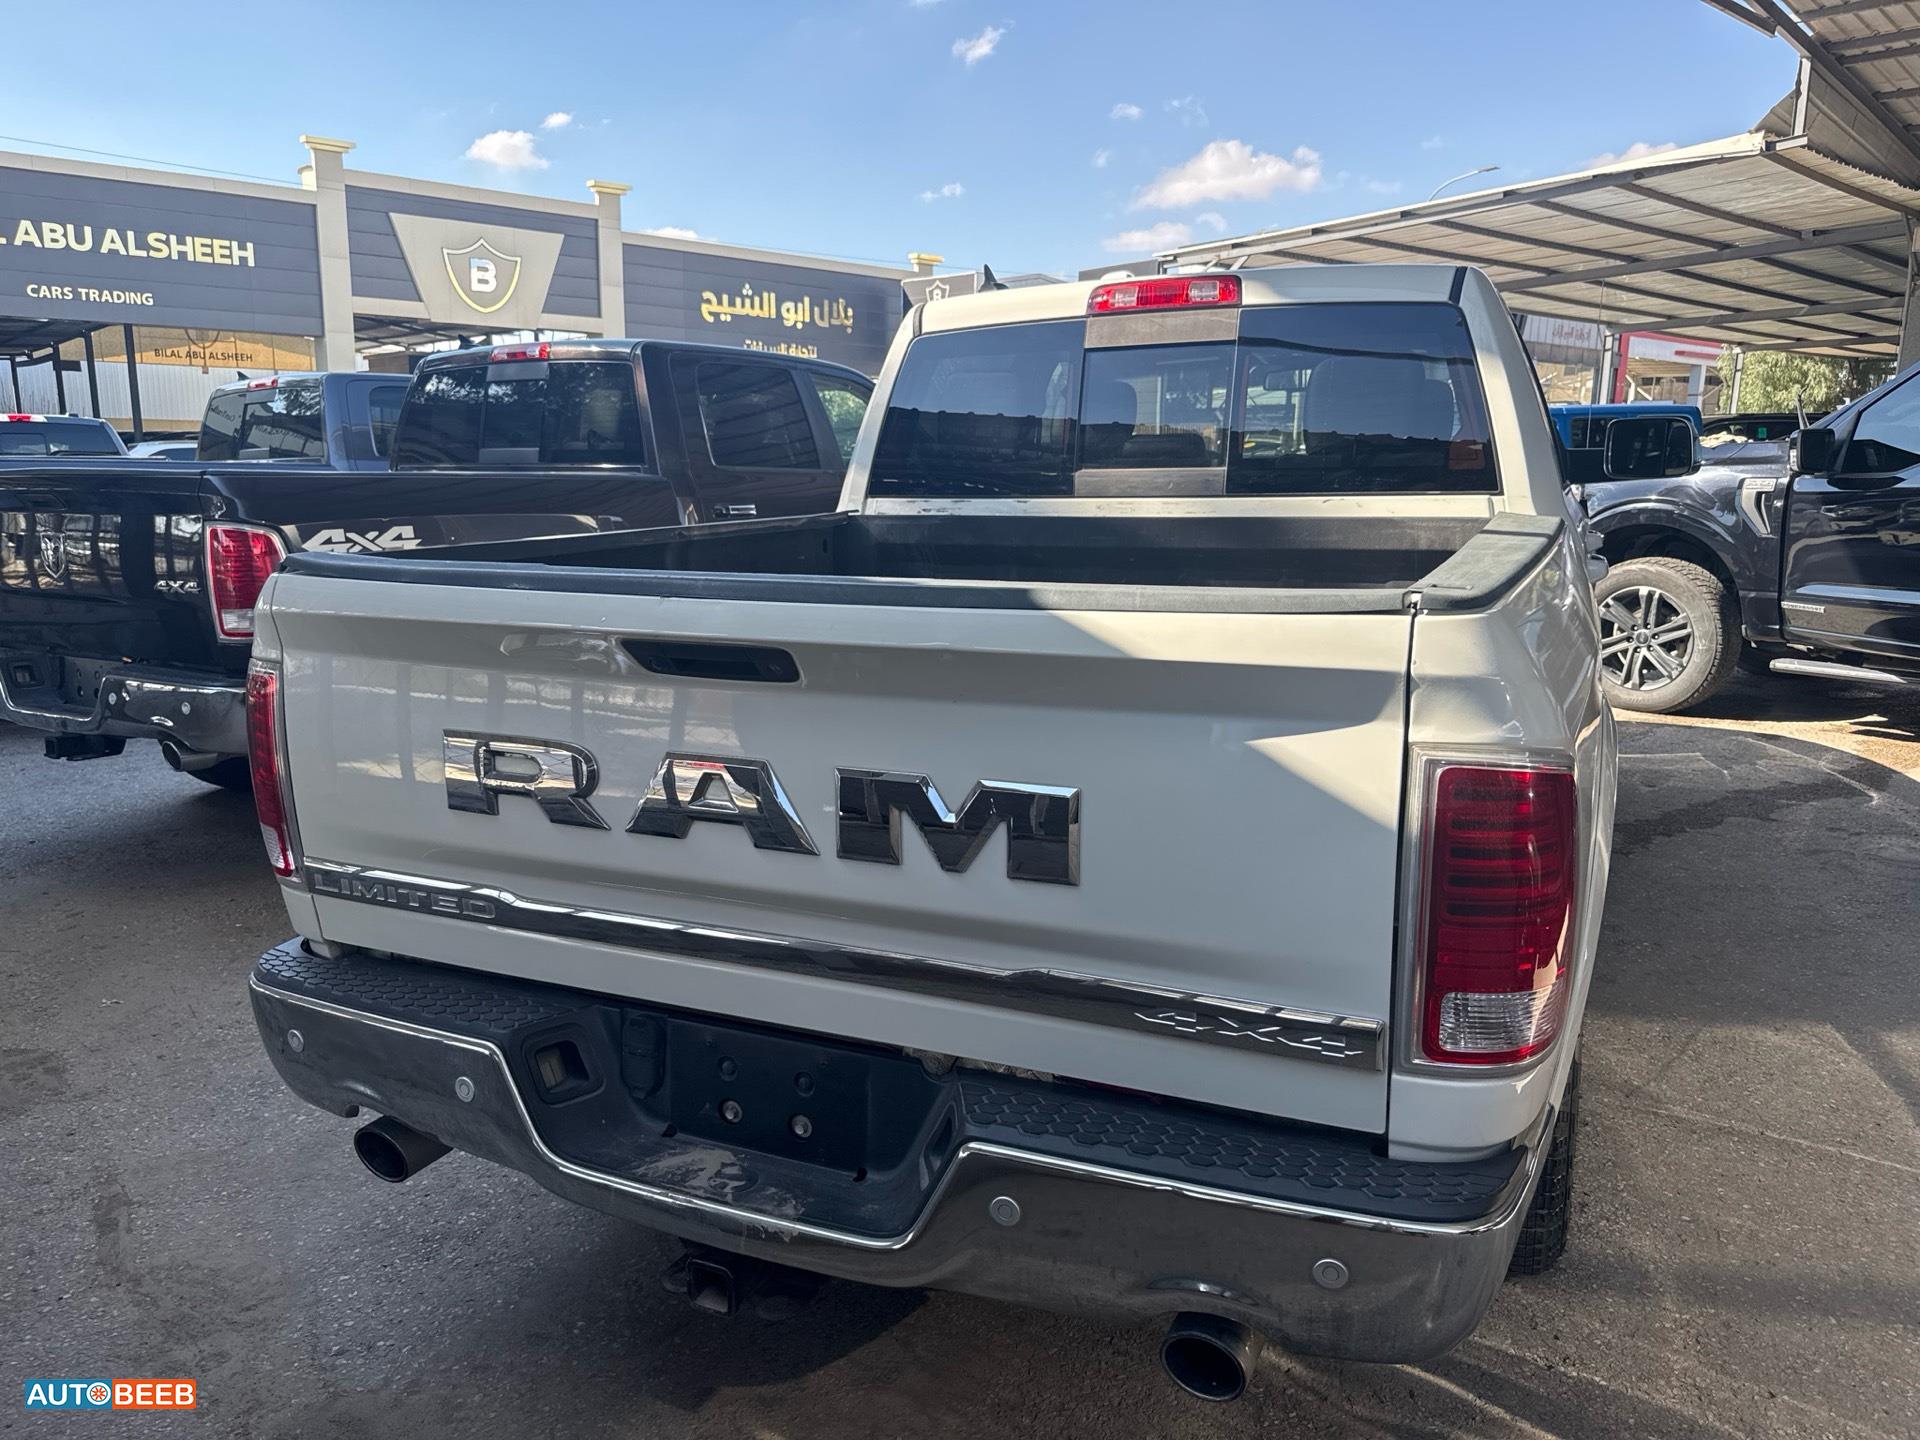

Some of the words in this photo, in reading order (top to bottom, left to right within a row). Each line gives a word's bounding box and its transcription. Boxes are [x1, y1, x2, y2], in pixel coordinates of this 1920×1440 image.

[14, 219, 93, 252] ABU
[101, 228, 255, 267] ALSHEEH
[470, 256, 497, 292] B
[27, 284, 73, 300] CARS
[78, 287, 154, 306] TRADING
[781, 295, 811, 330] ابو
[814, 298, 854, 334] بلال
[154, 348, 183, 359] BILAL
[185, 351, 206, 360] ABU
[208, 352, 254, 363] ALSHEEH
[442, 729, 1081, 887] RAM
[314, 872, 497, 919] LIMITED
